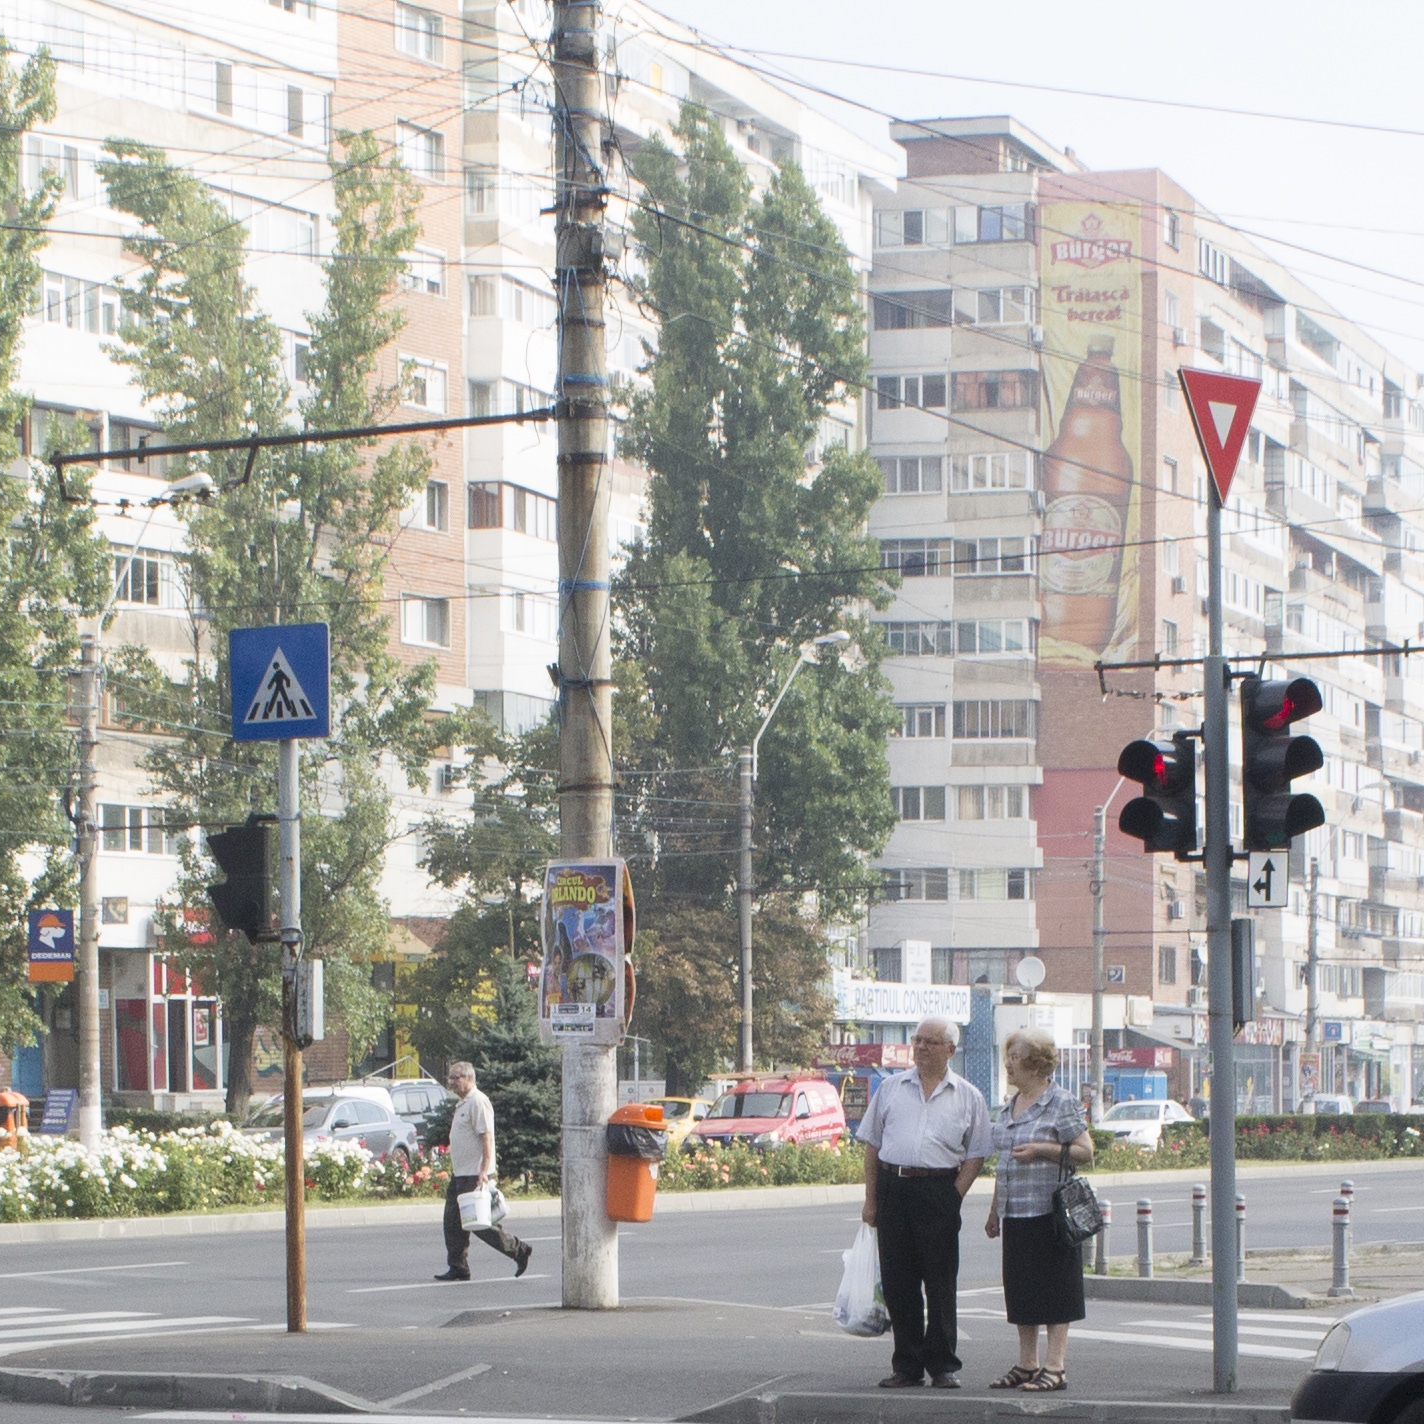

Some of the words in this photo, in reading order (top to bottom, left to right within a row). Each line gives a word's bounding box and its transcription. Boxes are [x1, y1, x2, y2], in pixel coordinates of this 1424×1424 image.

[31, 952, 72, 961] DEDEMAN
[855, 987, 901, 1015] PARTIDUL
[903, 989, 968, 1015] CONSERVATOR
